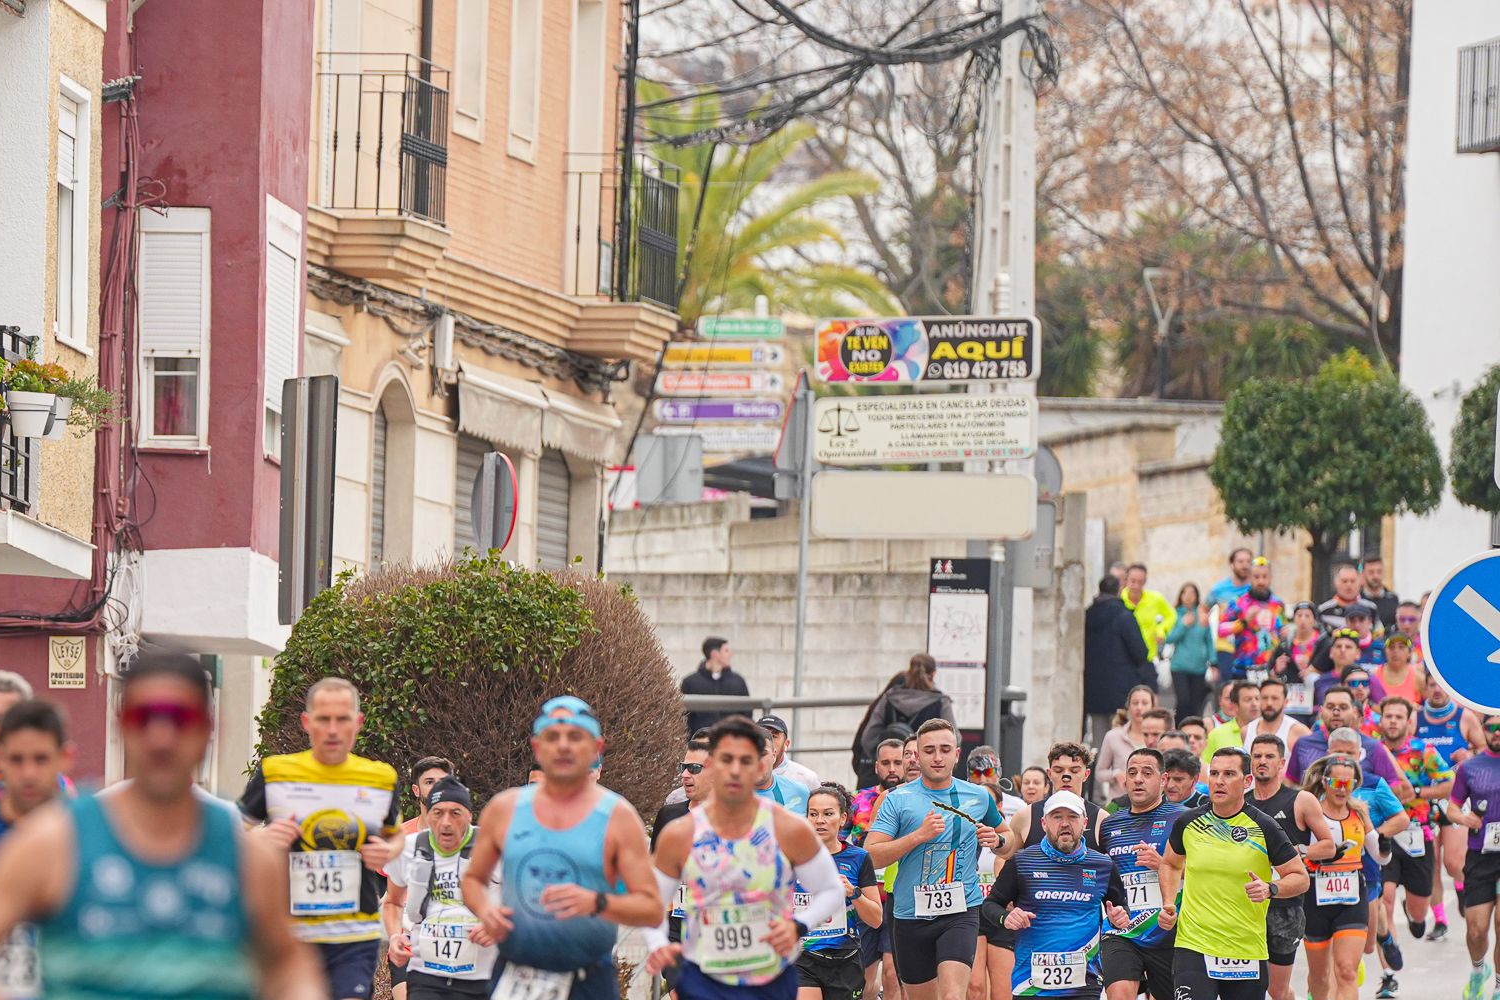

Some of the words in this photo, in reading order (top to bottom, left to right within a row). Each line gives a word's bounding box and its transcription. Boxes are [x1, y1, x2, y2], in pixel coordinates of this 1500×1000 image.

[929, 321, 1028, 338] ANÚNCIATE
[846, 336, 861, 350] TE
[862, 336, 888, 350] VEN
[931, 336, 1024, 361] AQUÍ
[852, 350, 881, 361] NO
[943, 362, 970, 378] 619
[972, 361, 998, 378] 472
[856, 400, 924, 412] ESPECIALISTAS
[926, 400, 938, 410] EN
[940, 399, 988, 410] CANCELAR
[990, 398, 1027, 408] DEUDAS
[56, 645, 80, 659] LEYSE
[306, 871, 344, 894] 345
[1326, 878, 1350, 893] 404
[924, 891, 952, 910] 733
[1034, 890, 1092, 902] enerplus
[1130, 885, 1148, 904] 71
[714, 924, 753, 951] 999
[432, 940, 462, 960] 147
[1043, 967, 1073, 986] 232
